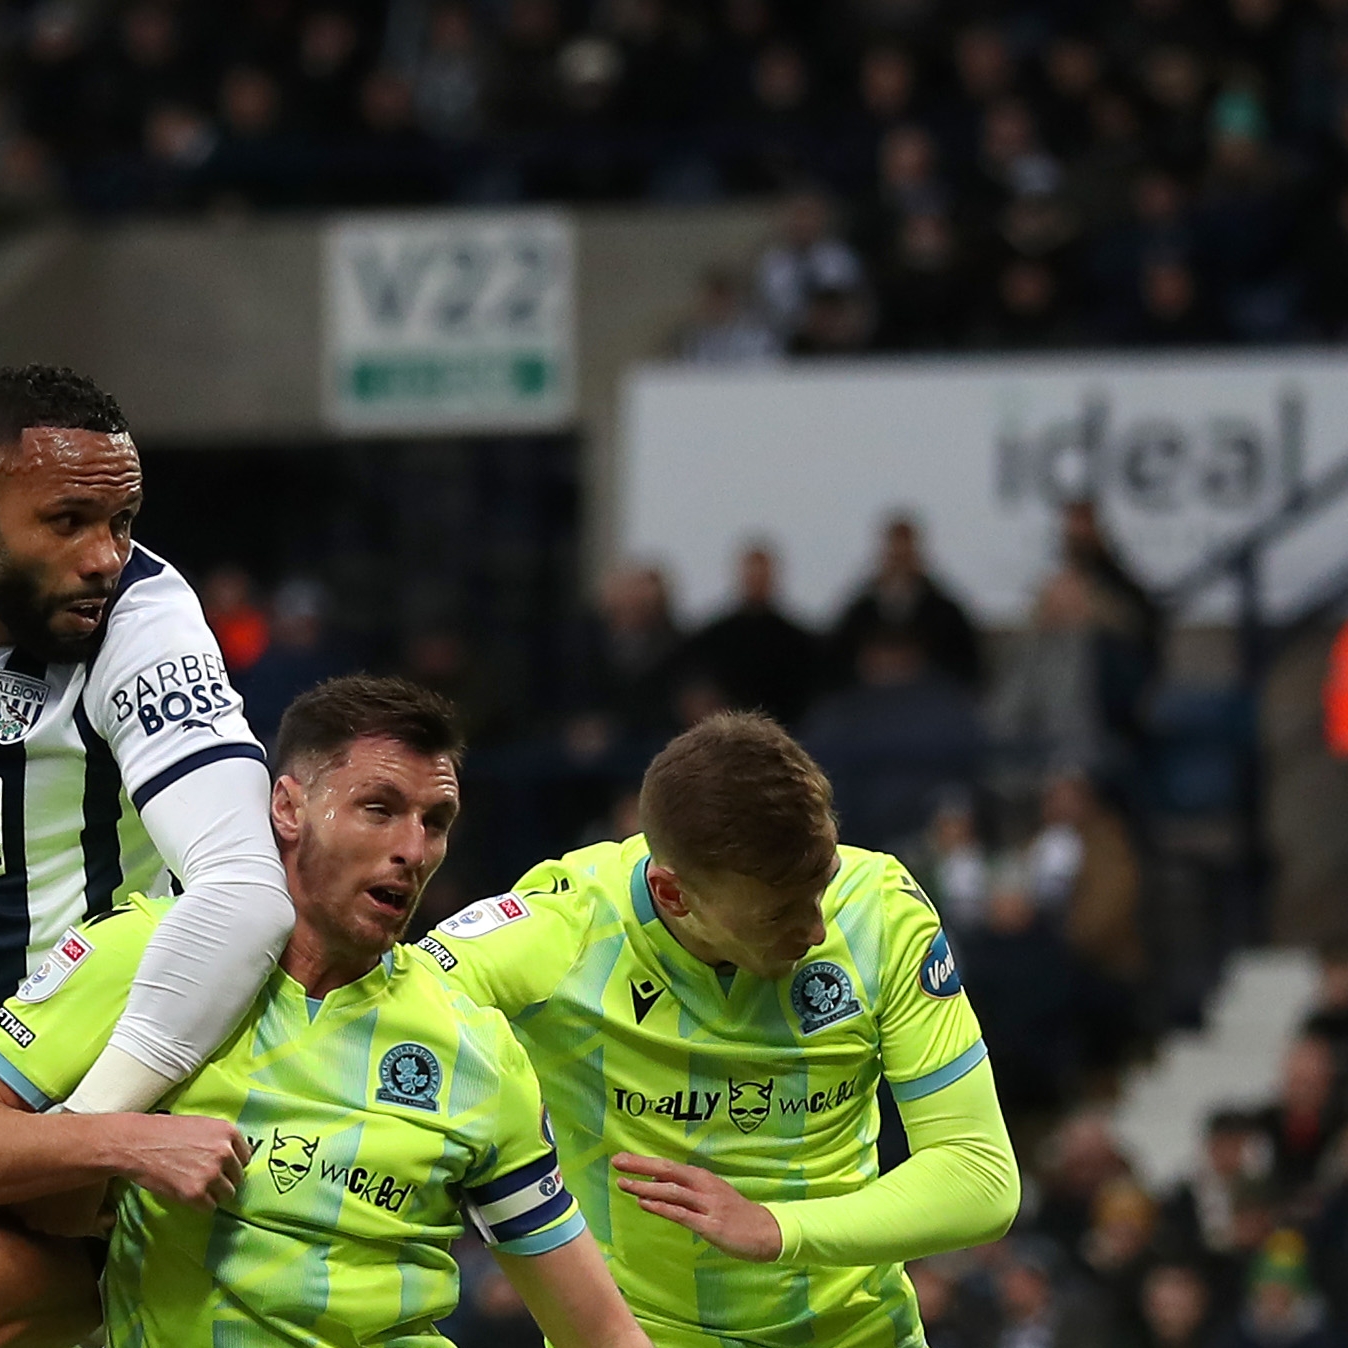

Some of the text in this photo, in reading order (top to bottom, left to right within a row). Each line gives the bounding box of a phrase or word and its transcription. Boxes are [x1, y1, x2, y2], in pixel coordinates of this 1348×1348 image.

[350, 242, 554, 334] V22
[995, 382, 1312, 512] ideal
[138, 682, 232, 737] BOSS
